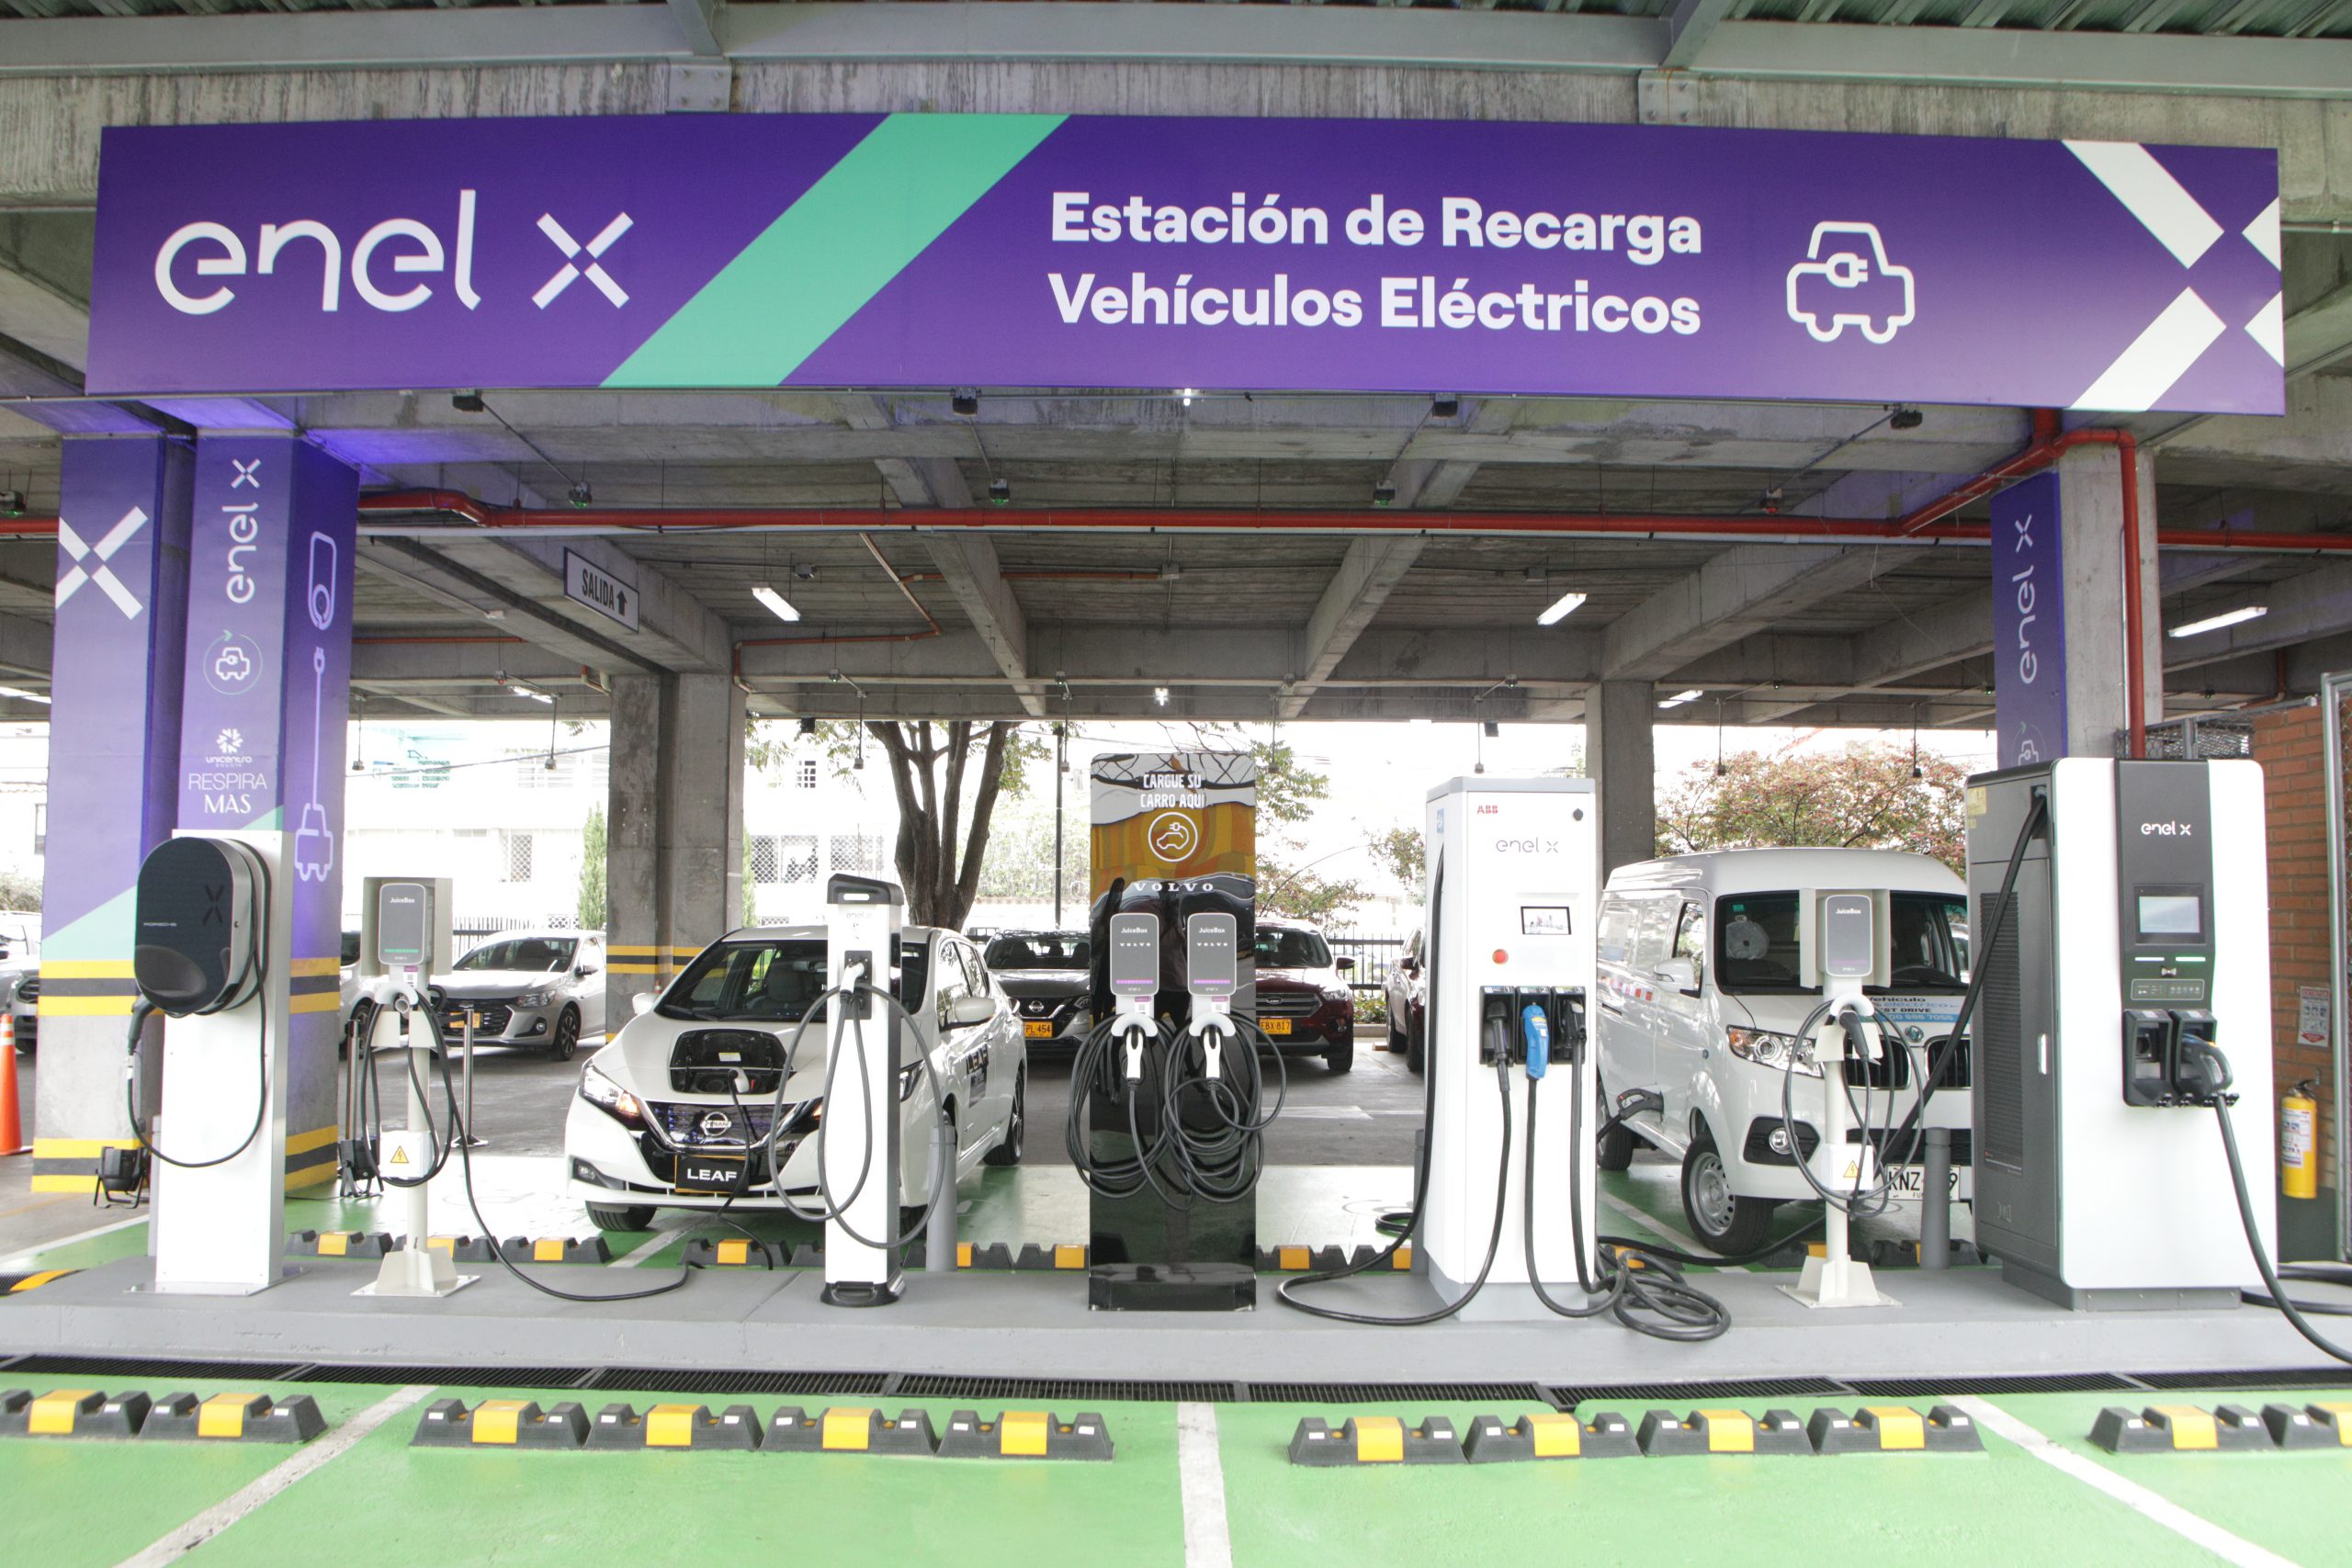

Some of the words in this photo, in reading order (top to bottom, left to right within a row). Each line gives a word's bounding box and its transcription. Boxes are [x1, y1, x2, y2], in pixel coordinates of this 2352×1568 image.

[1052, 191, 1329, 244] Estación
[1345, 194, 1424, 245] de
[1442, 197, 1702, 265] Recarga
[154, 189, 481, 314] enel
[1047, 272, 1363, 326] Vehículos
[1381, 276, 1701, 334] Eléctricos
[222, 502, 259, 604] enel
[582, 568, 615, 610] SALIDA
[2012, 564, 2037, 684] enel
[188, 773, 267, 790] RESPIRA
[1143, 773, 1184, 788] CARGUE
[1187, 773, 1202, 788] SU
[1139, 793, 1176, 807] CARRO
[1476, 805, 1498, 814] ABB
[2141, 820, 2177, 836] enel
[1496, 837, 1540, 853] enel
[1133, 883, 1214, 892] VOLVO
[1836, 907, 1861, 915] JuiceBox
[1037, 1024, 1051, 1033] 454
[687, 1168, 738, 1182] LEAF
[1889, 1171, 1920, 1190] KNZ
